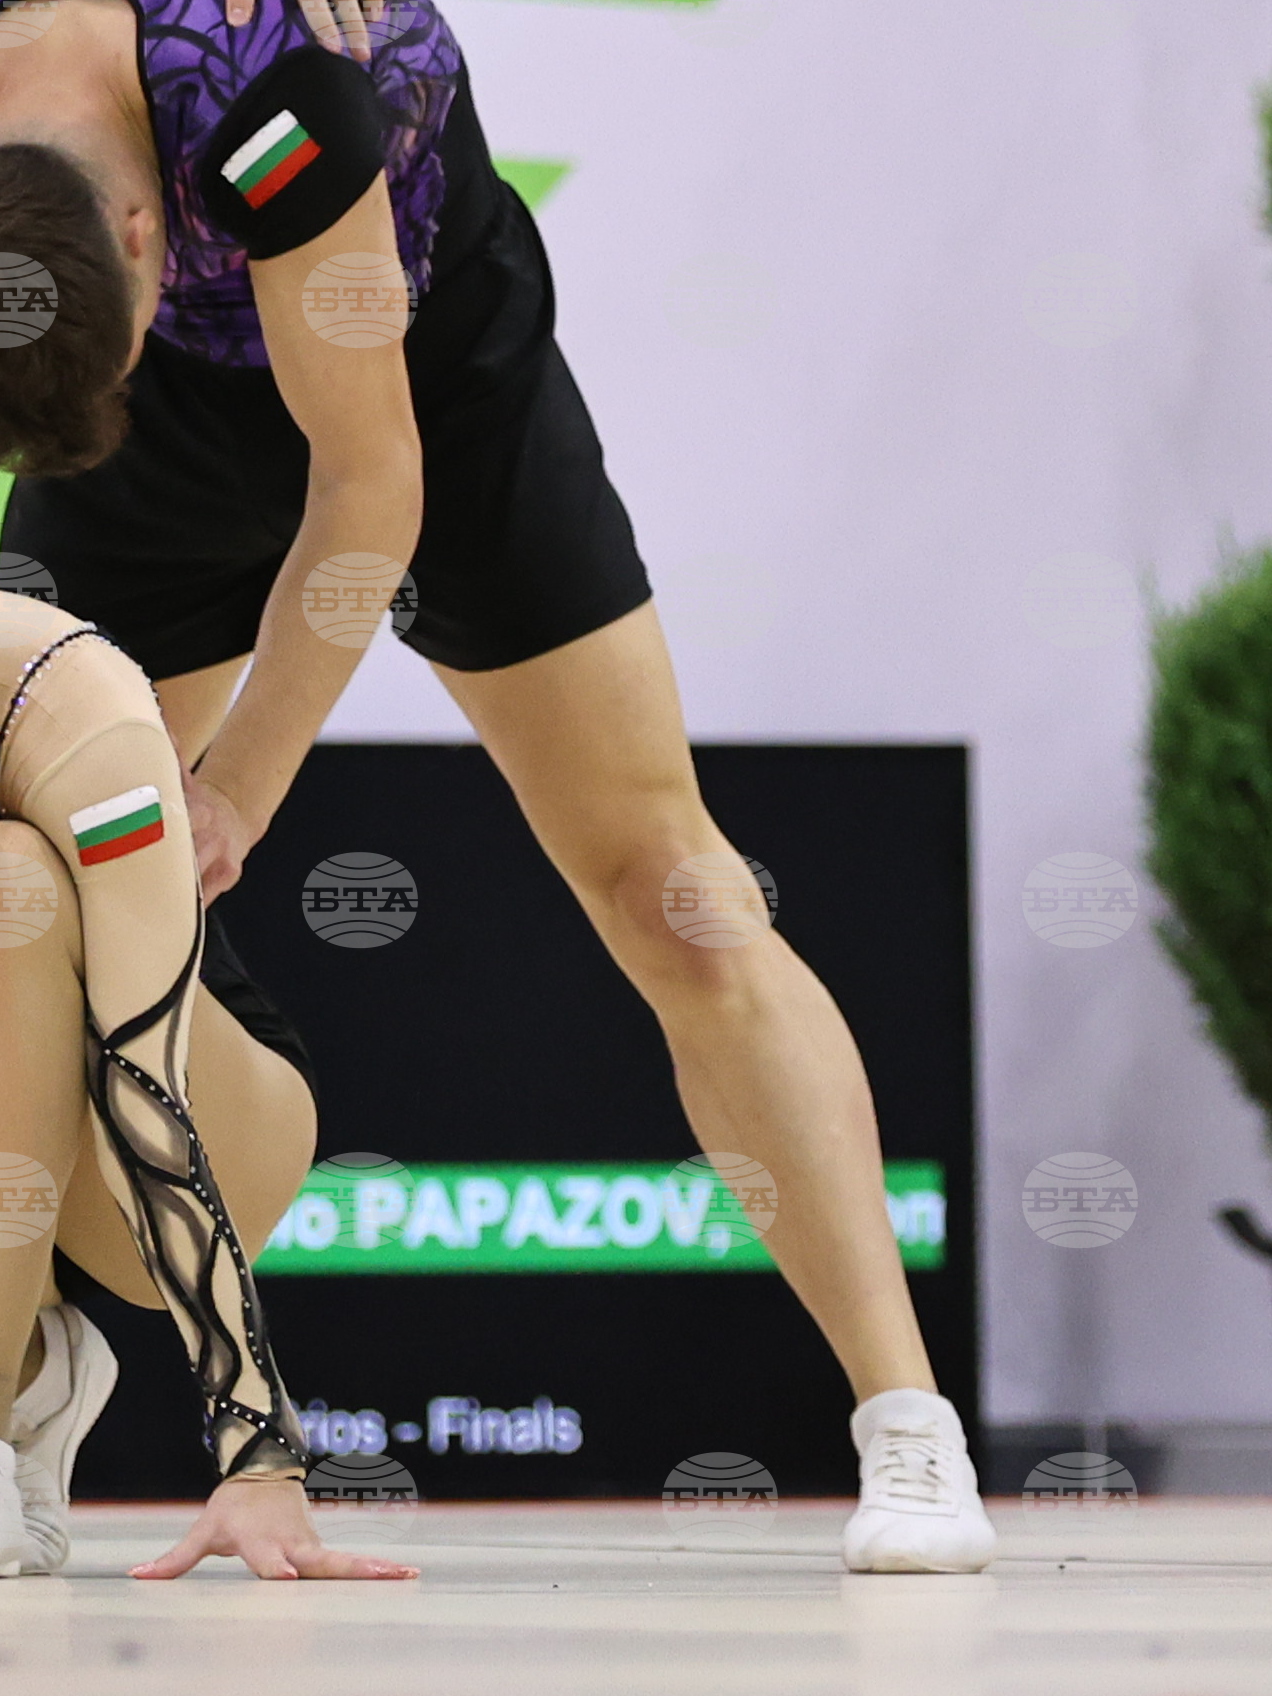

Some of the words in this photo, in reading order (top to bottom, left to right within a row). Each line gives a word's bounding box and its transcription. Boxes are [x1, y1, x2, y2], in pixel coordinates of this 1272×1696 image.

[353, 1176, 731, 1259] PAPAZOV,
[291, 1398, 388, 1455] rios
[427, 1395, 583, 1455] Finals
